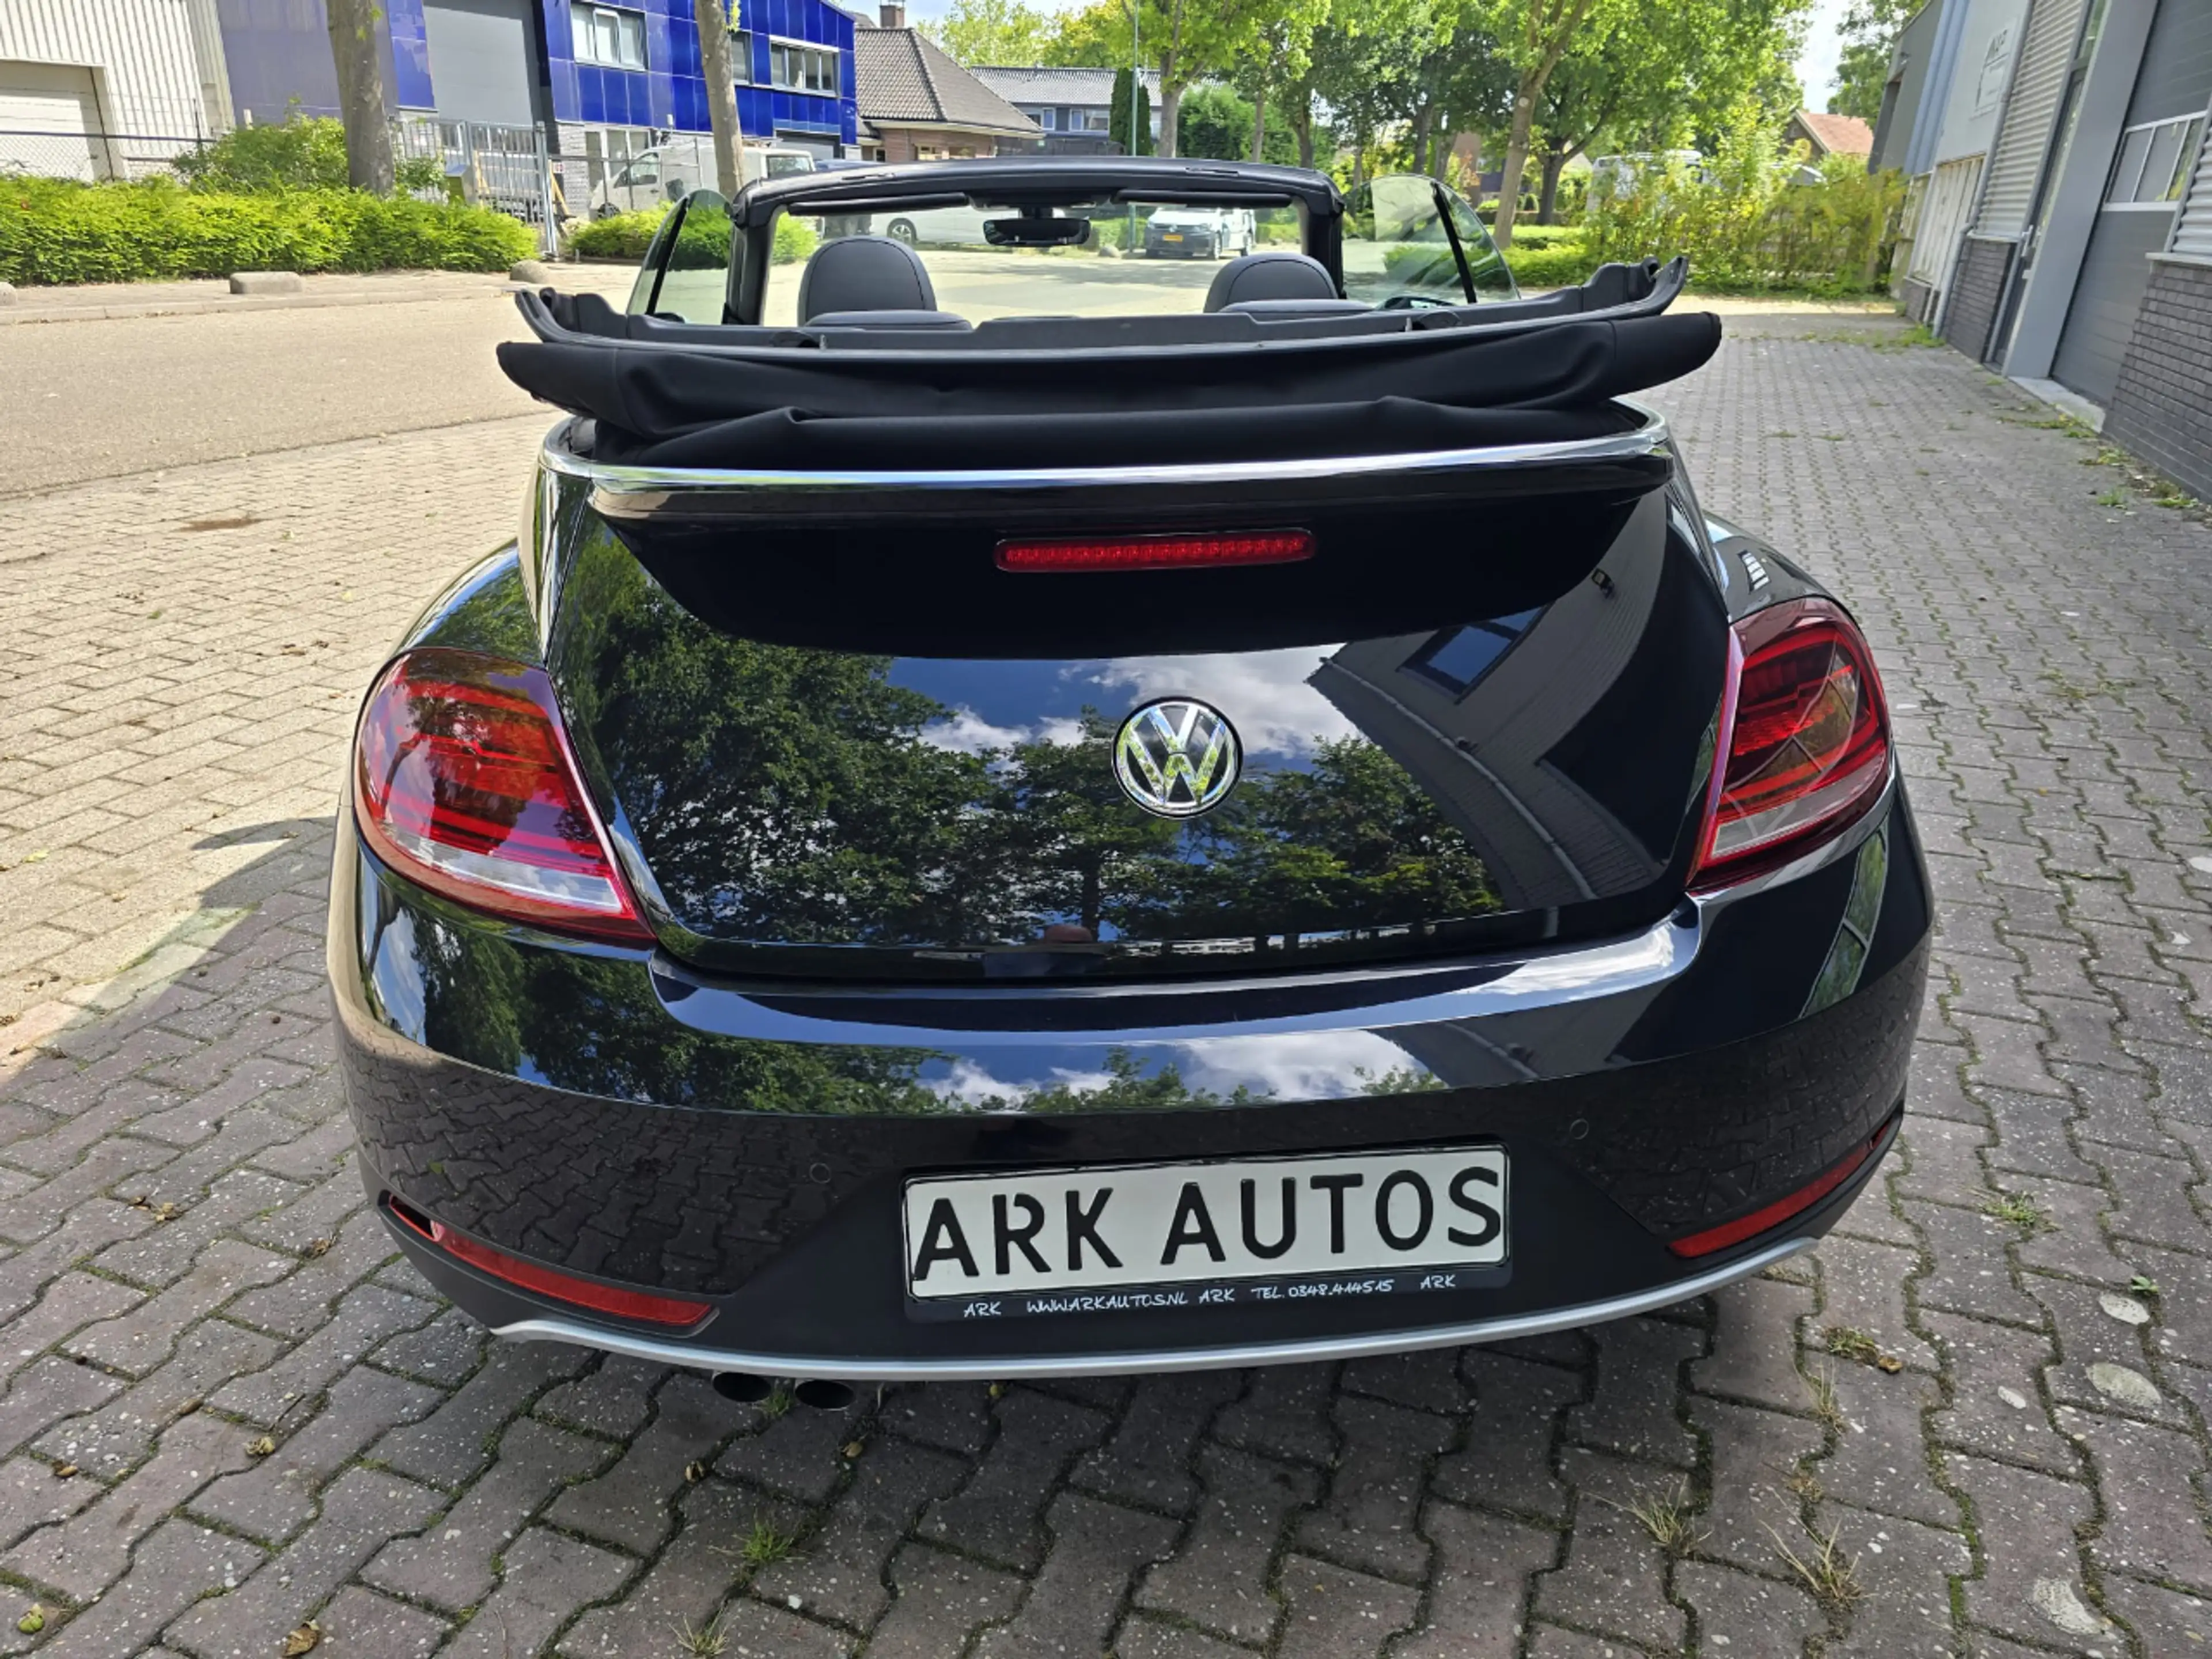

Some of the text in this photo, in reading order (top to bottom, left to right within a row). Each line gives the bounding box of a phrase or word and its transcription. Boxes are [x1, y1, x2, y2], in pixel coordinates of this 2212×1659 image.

[913, 1166, 1501, 1281] ARK AUTOS
[964, 1301, 1002, 1318] ARK
[1199, 1288, 1236, 1305] ARK
[1420, 1274, 1456, 1290] ARK
